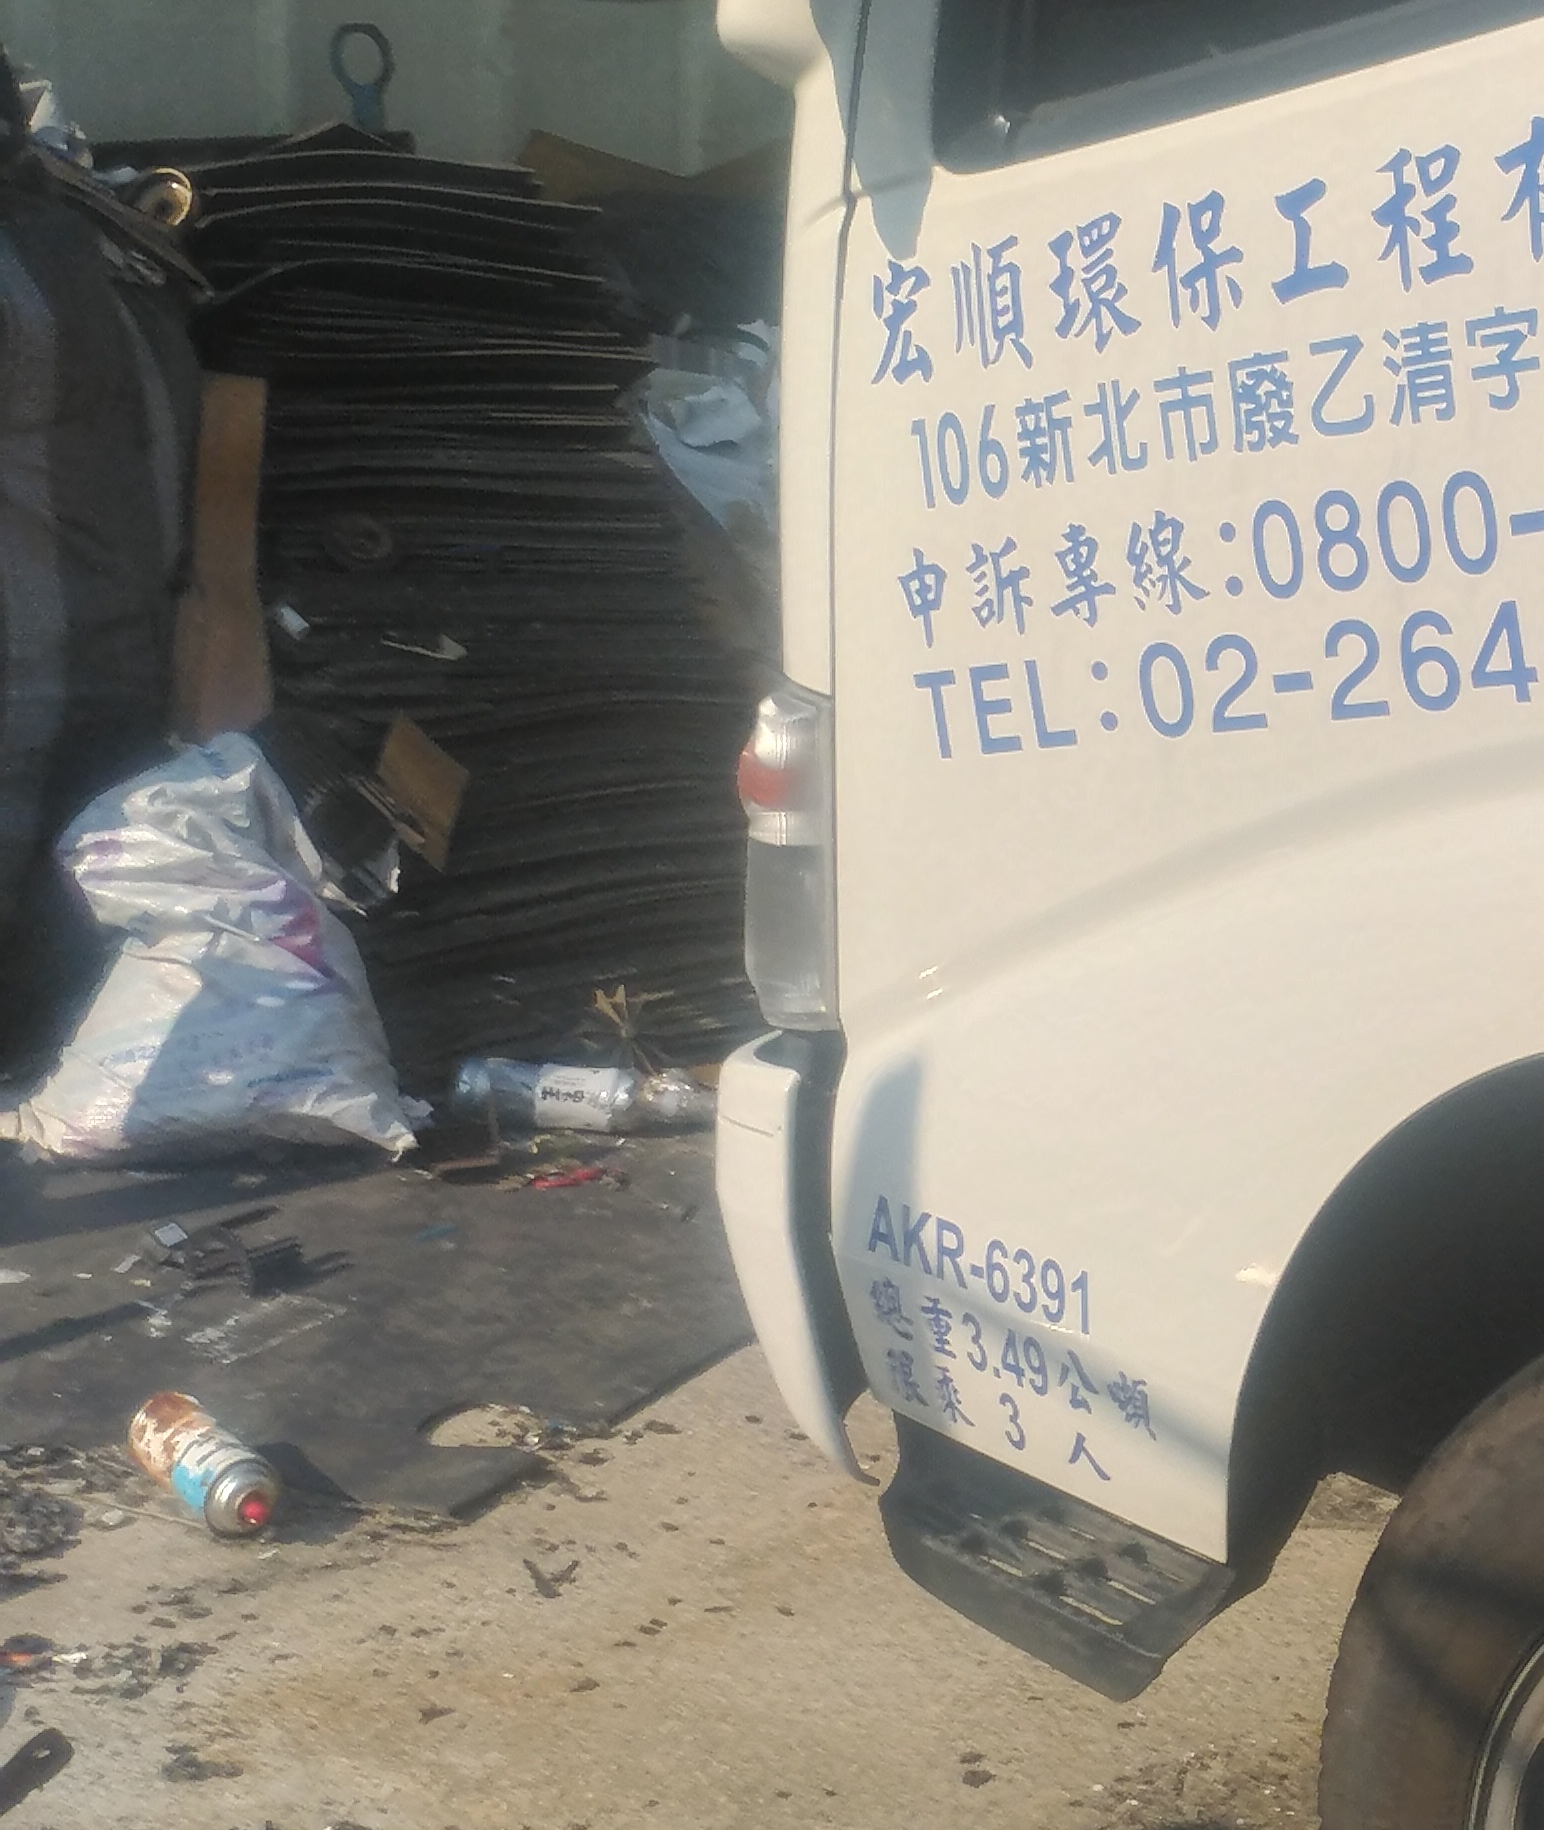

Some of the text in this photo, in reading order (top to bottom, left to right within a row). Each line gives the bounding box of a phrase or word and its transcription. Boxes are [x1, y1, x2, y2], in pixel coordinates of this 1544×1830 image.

[868, 1195, 1090, 1335] AKR-6391
[999, 1393, 1026, 1451] 3
[1068, 1432, 1111, 1481] 人
